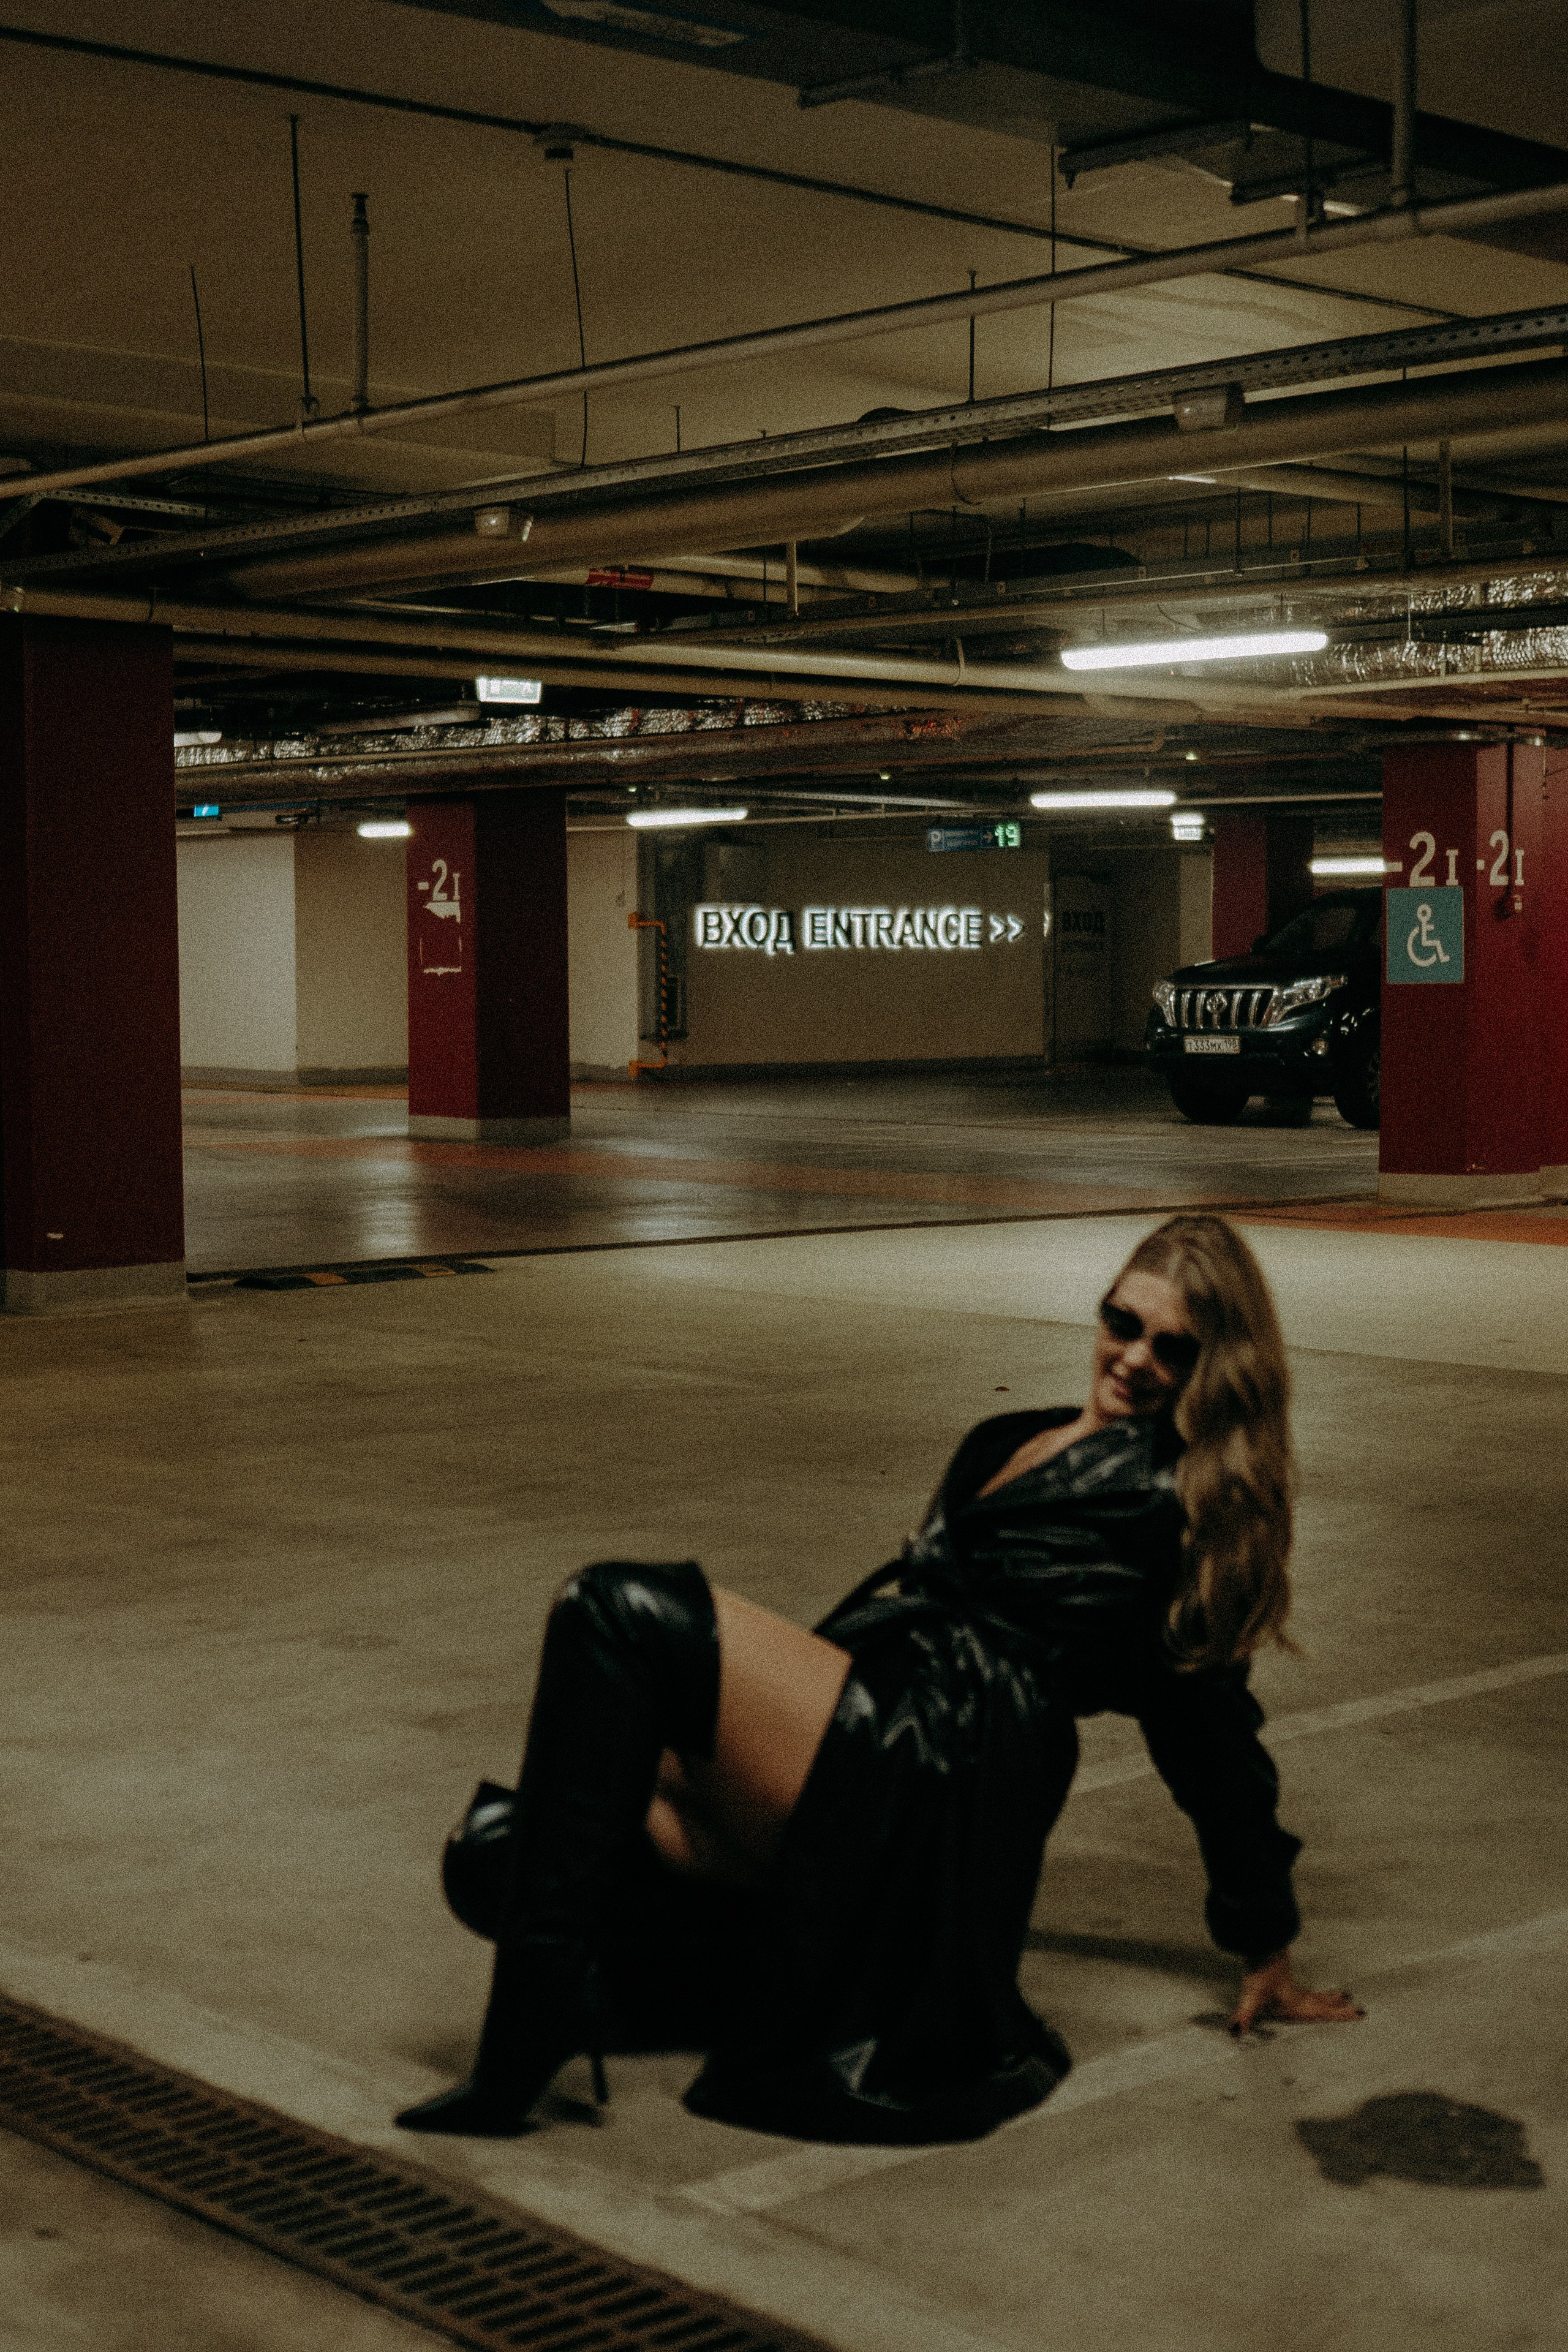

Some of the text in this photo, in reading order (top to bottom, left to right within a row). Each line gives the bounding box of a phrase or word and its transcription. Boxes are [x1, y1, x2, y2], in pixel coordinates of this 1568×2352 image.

[930, 830, 941, 849] P
[994, 824, 1019, 847] 19
[697, 908, 982, 955] ВХОД ENTRANCE
[1062, 911, 1106, 934] ВХОД
